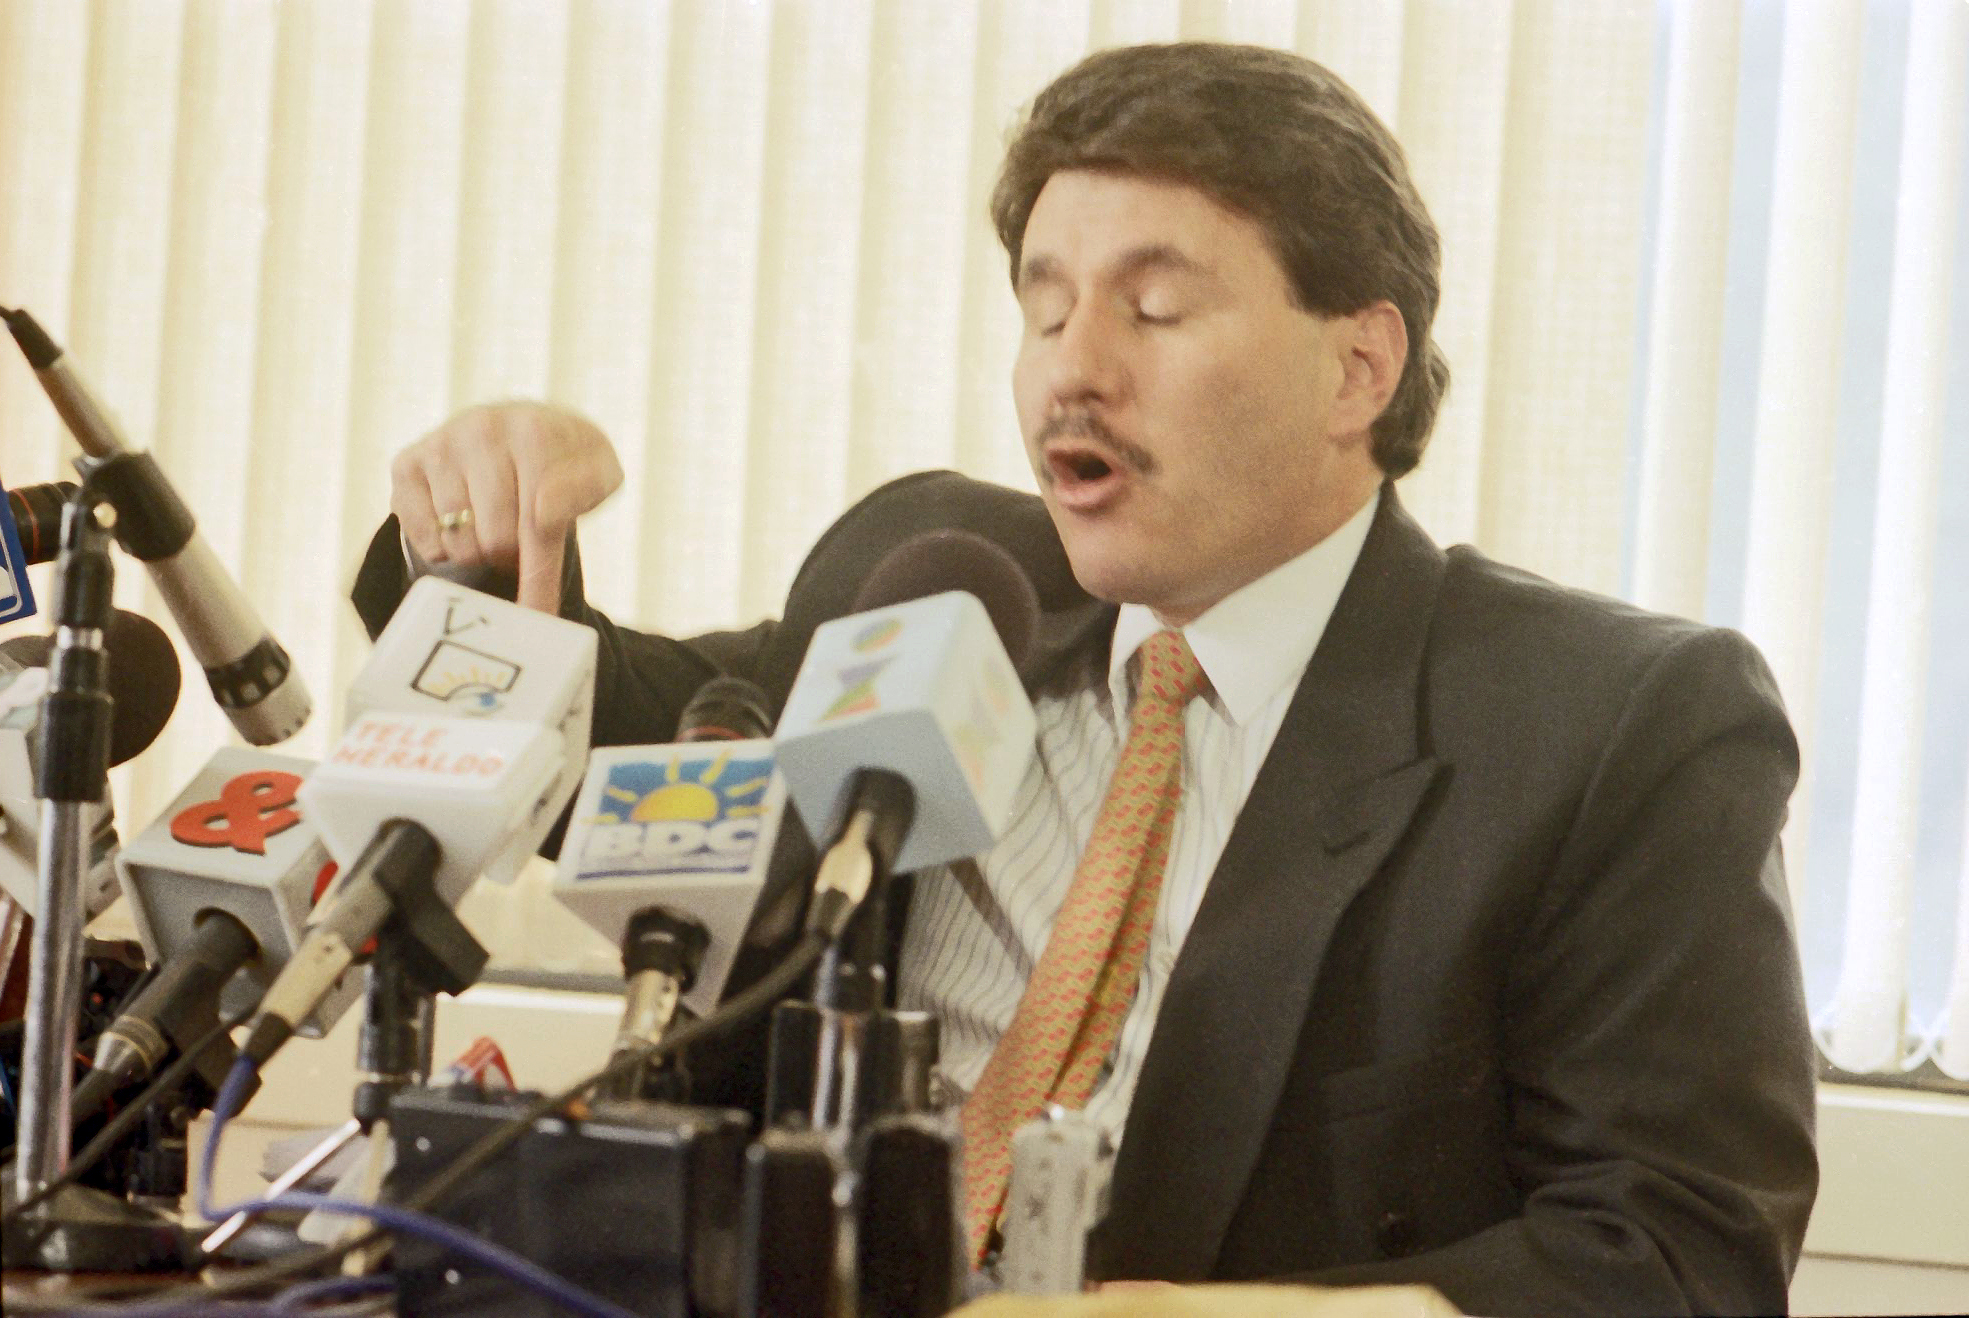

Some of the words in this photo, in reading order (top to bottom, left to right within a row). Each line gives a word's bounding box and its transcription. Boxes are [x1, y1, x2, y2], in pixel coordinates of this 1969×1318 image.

[356, 719, 449, 748] TELE
[331, 746, 504, 777] HERALDO
[583, 819, 762, 860] BDC
